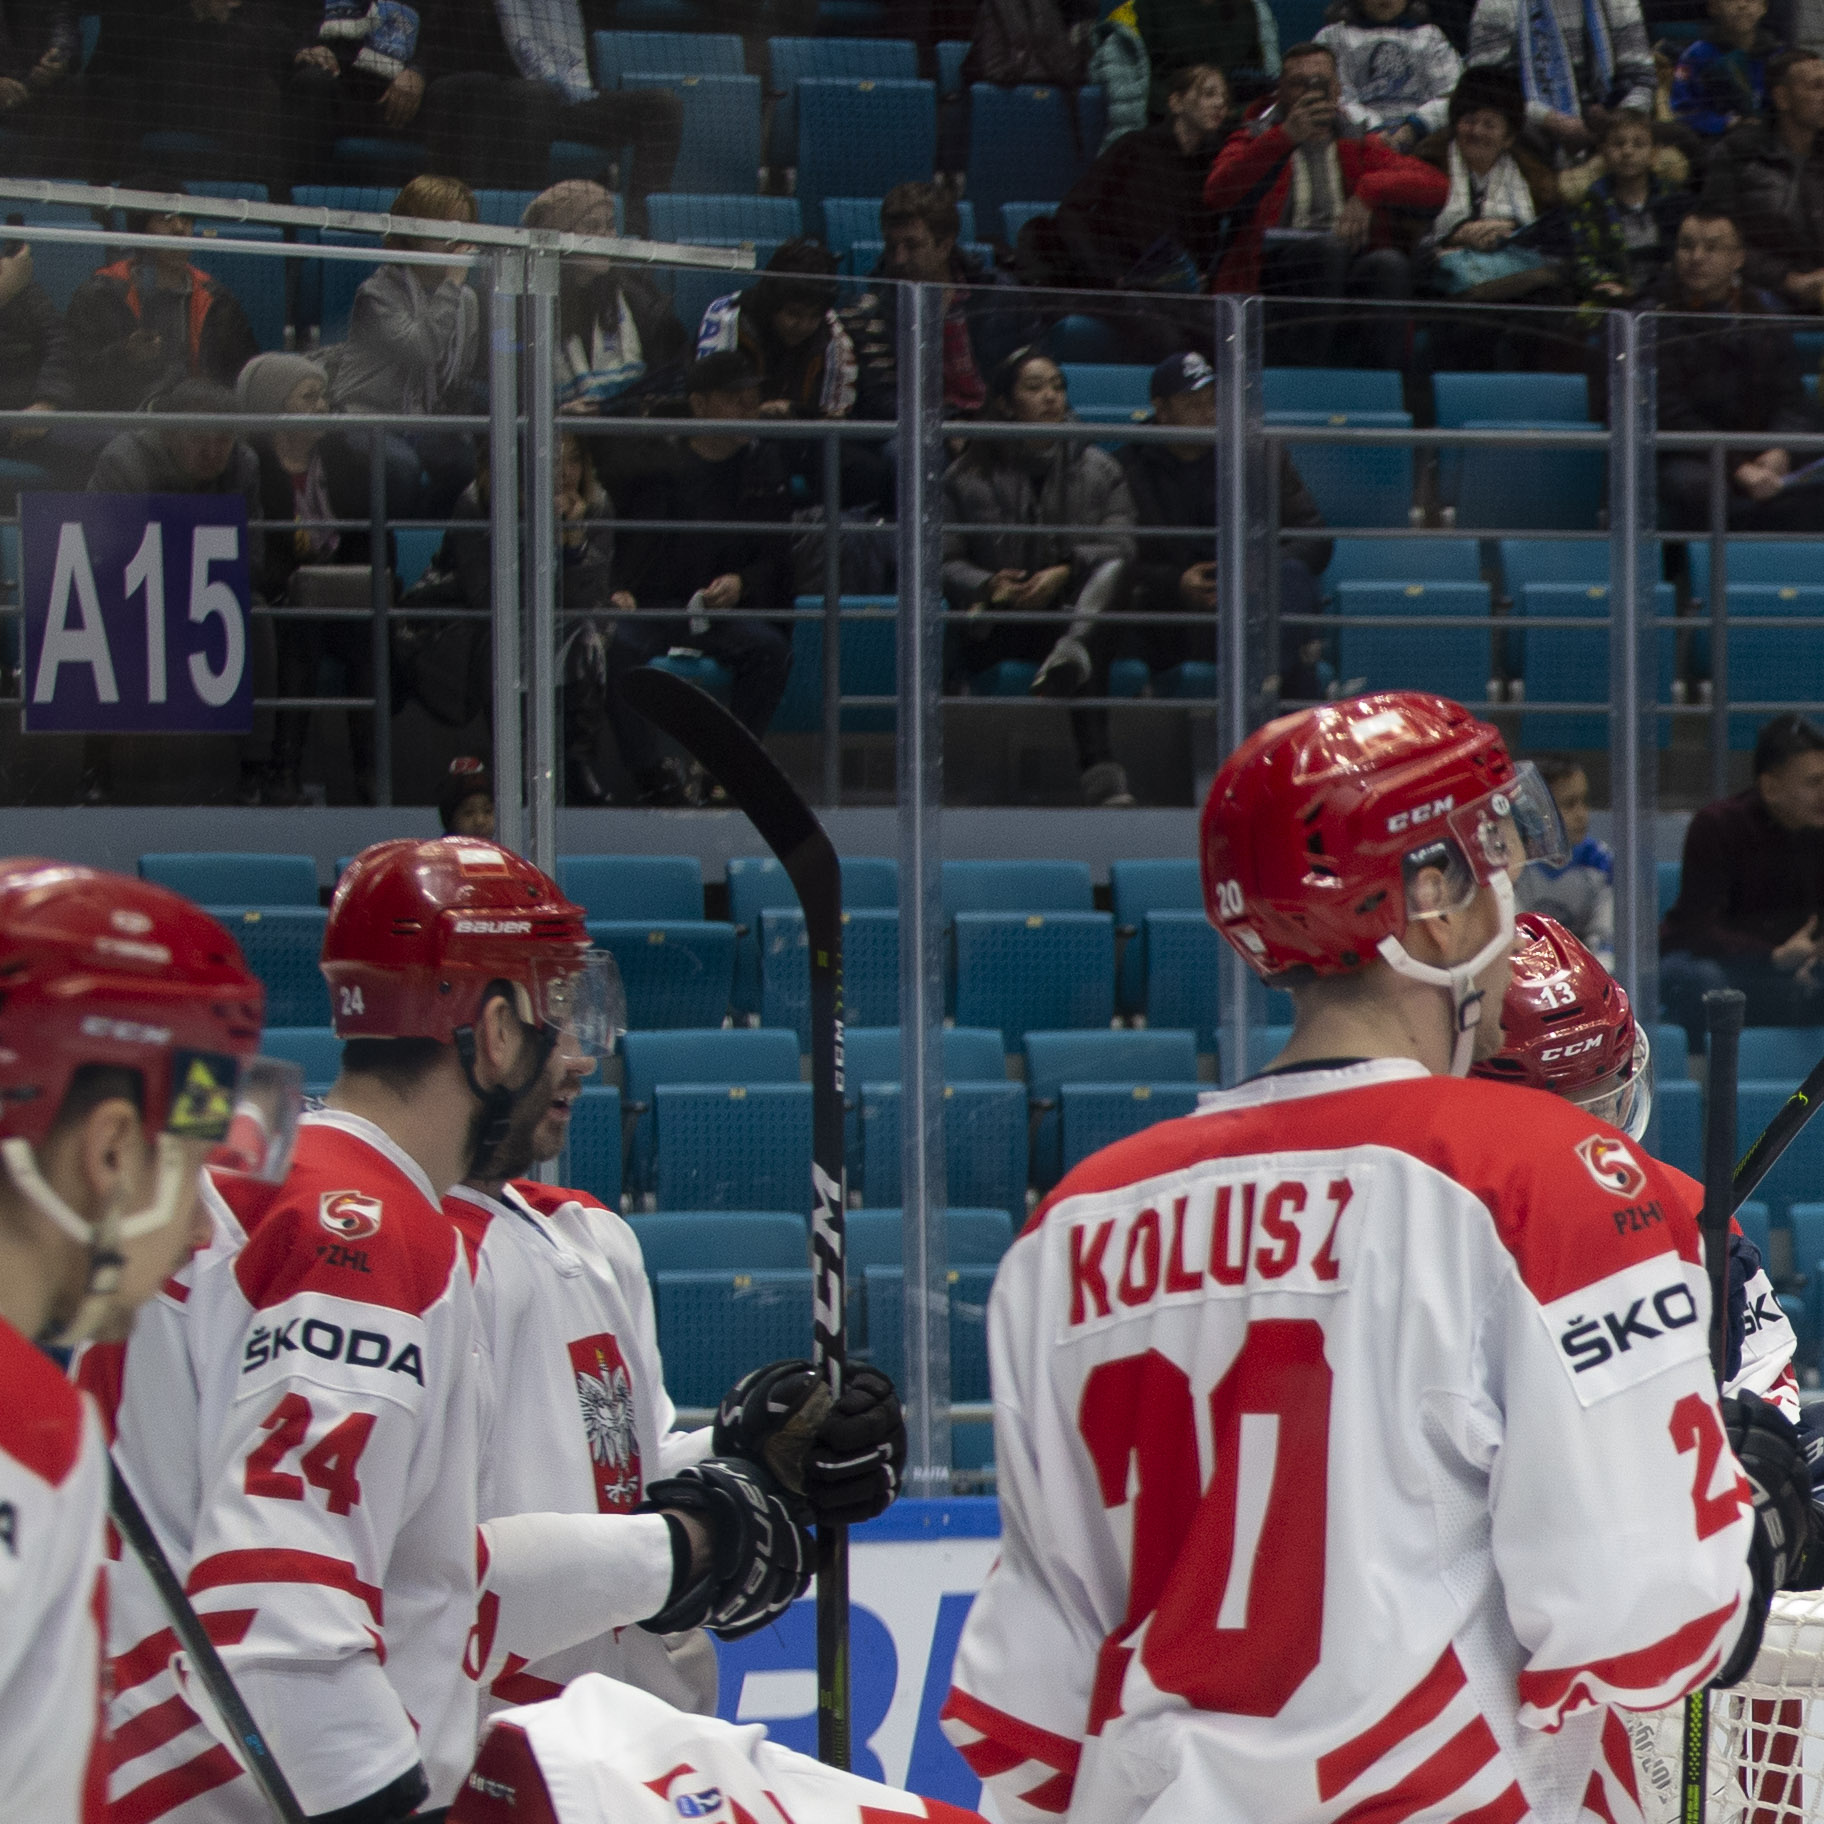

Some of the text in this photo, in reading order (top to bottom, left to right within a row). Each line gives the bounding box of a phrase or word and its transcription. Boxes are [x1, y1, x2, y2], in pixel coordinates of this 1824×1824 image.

[33, 521, 247, 707] A15
[1386, 794, 1455, 834] CCM
[456, 920, 533, 934] BAUER
[1215, 879, 1246, 918] 20
[339, 985, 366, 1016] 24
[1539, 979, 1579, 1010] 13
[1541, 1031, 1604, 1064] CCM
[1068, 1176, 1355, 1326] KOLUSZ
[242, 1316, 426, 1387] ŠKODA
[1560, 1281, 1700, 1374] ŠKO
[243, 1391, 377, 1518] 24
[1667, 1393, 1754, 1542] 2
[1076, 1317, 1334, 1738] 20
